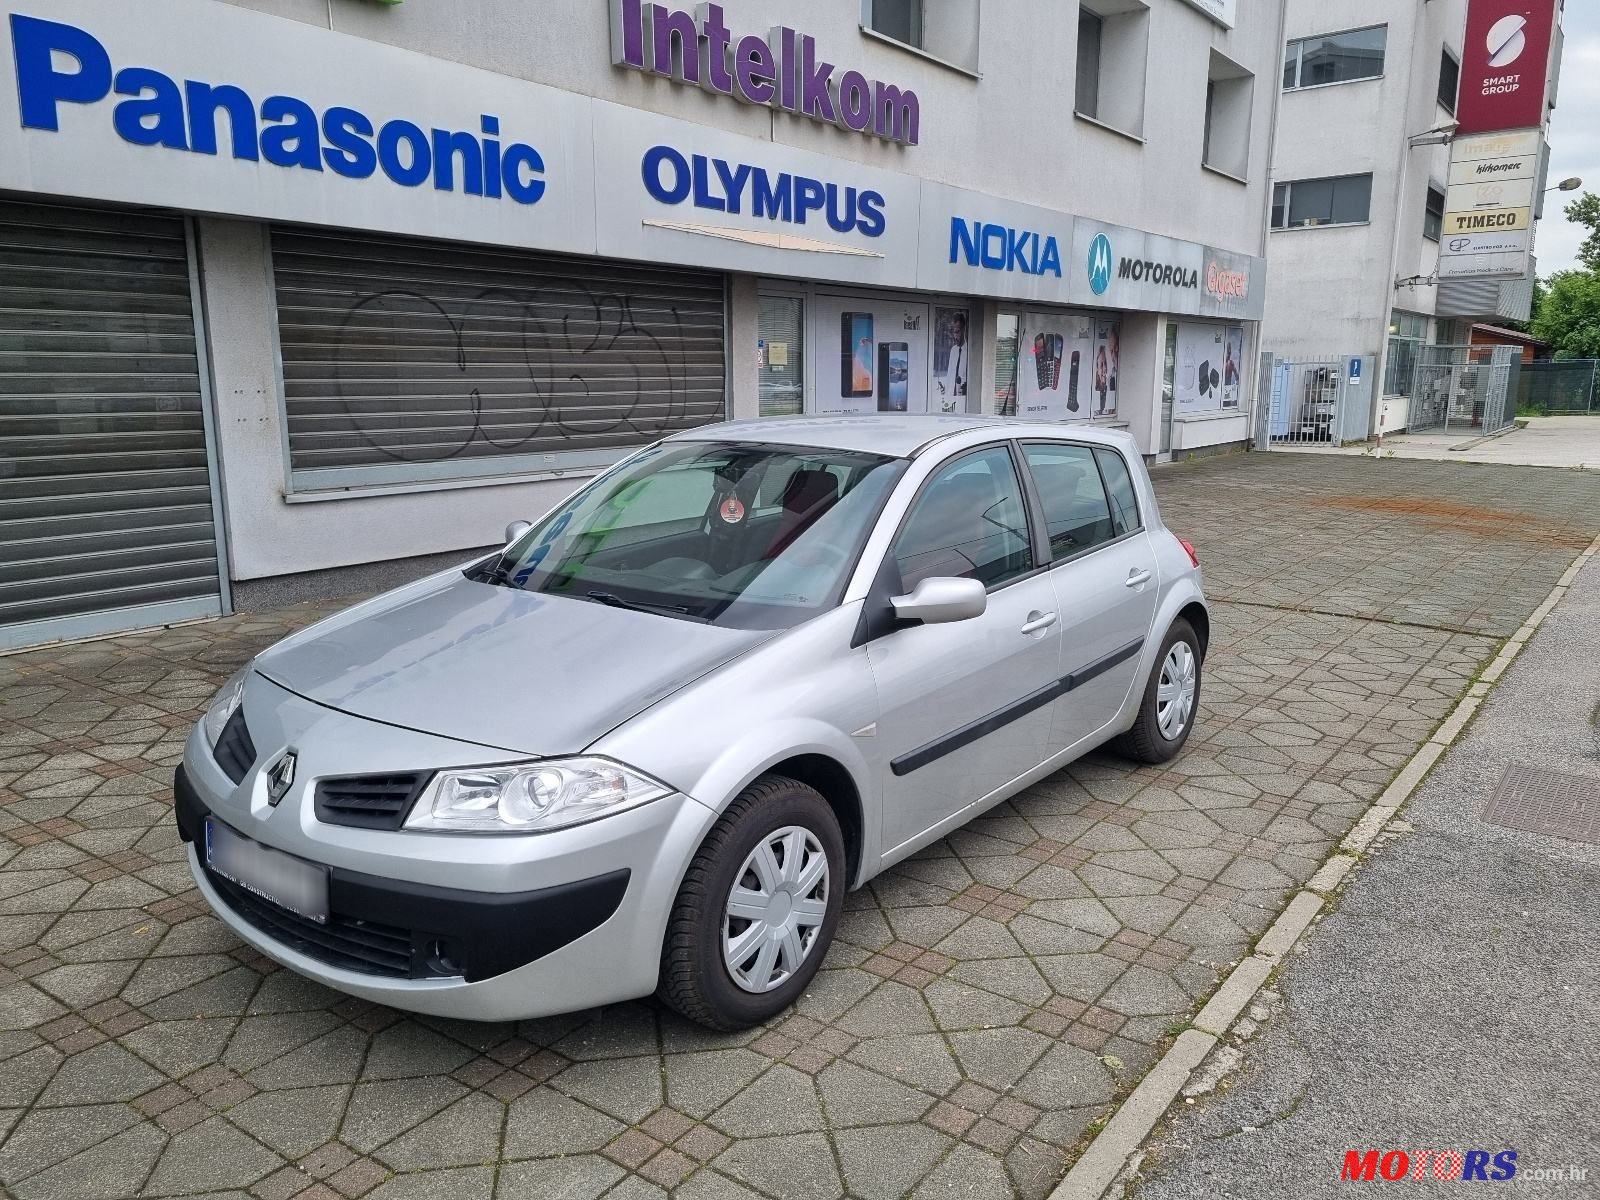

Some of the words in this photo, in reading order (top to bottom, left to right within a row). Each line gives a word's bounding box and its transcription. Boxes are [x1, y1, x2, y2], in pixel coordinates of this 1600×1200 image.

[613, 0, 919, 146] Intelkom
[1482, 83, 1520, 95] GROUP
[1483, 75, 1520, 87] SMART
[9, 13, 546, 204] Panasonic
[1476, 162, 1522, 174] kirkomerc
[641, 145, 886, 237] OLYMPUS
[1456, 212, 1516, 229] TIMECO
[949, 216, 1062, 278] NOKIA
[1118, 256, 1198, 290] MOTOROLA
[1206, 261, 1248, 303] Gigaset
